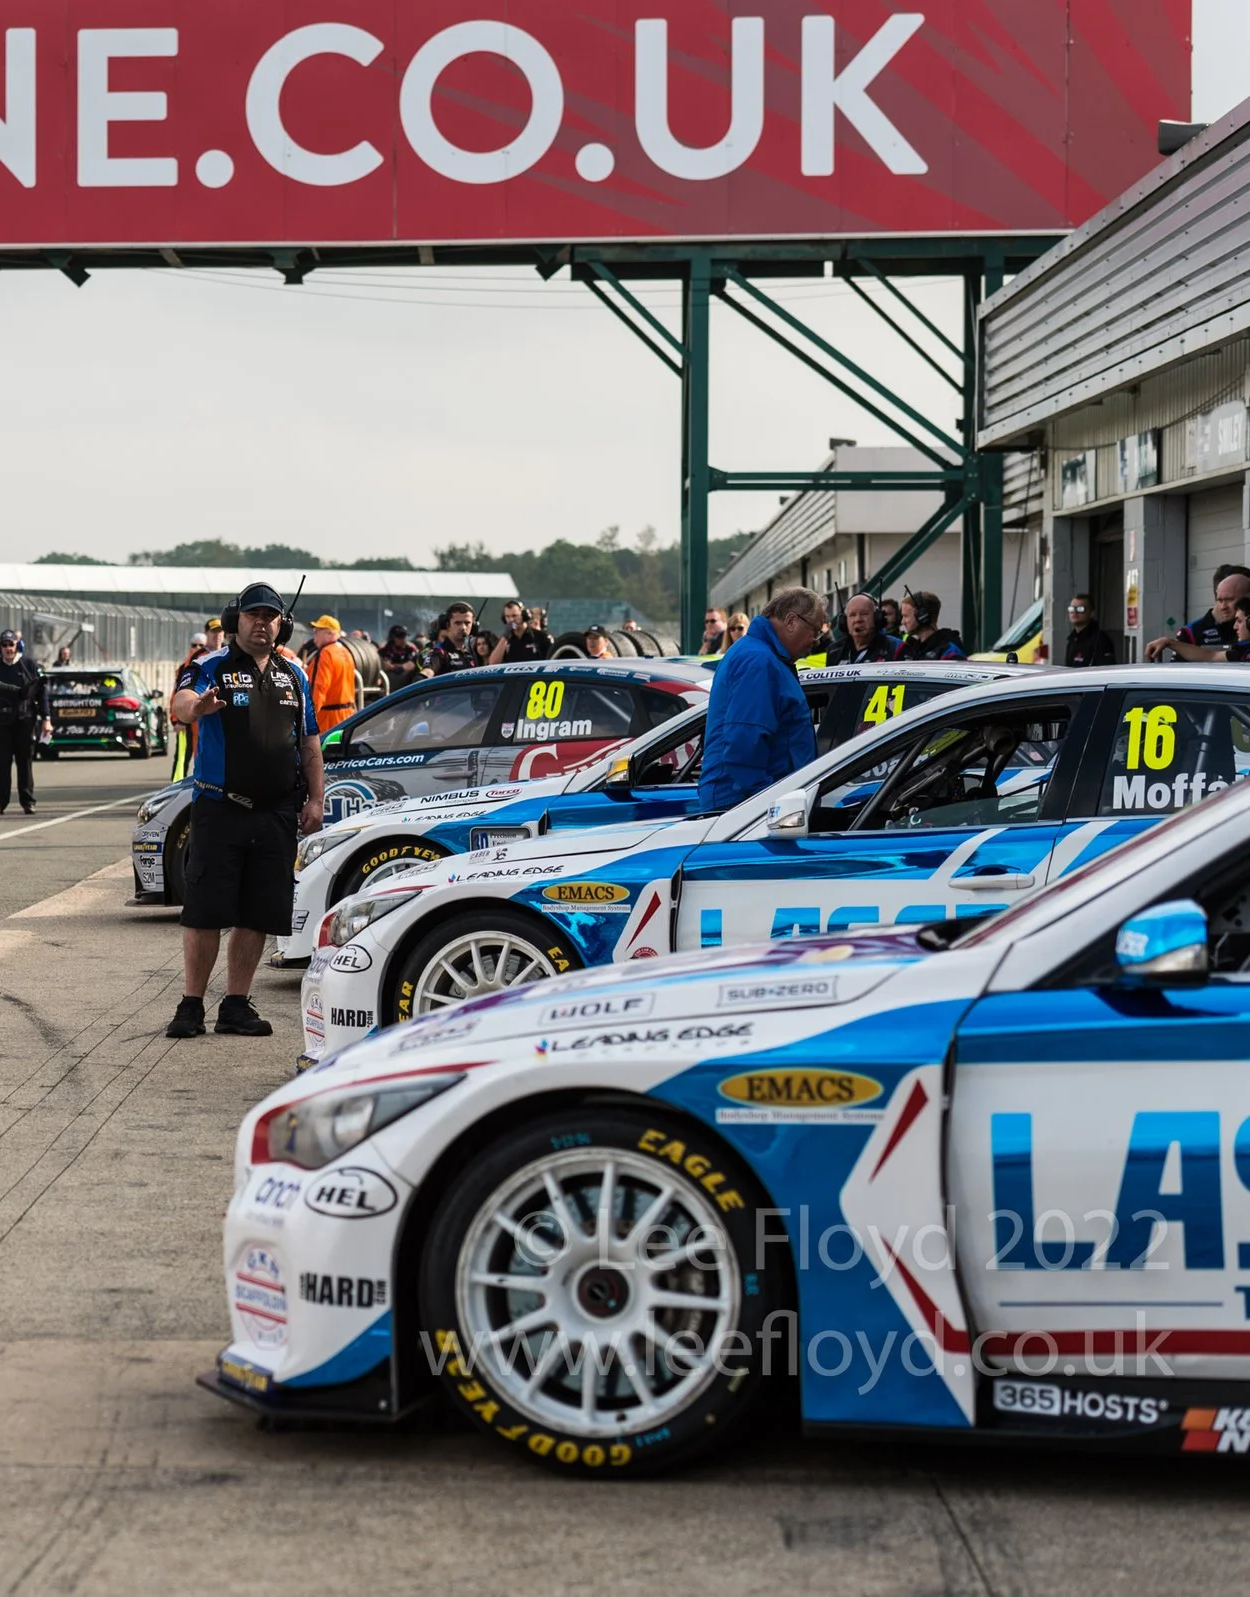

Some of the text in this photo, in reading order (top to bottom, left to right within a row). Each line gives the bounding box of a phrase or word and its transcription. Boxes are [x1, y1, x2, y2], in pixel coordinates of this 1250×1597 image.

[806, 671, 845, 680] COLITIS
[846, 669, 862, 677] UK
[526, 681, 565, 720] 80
[864, 685, 905, 726] 41
[516, 719, 592, 741] Ingram
[1125, 705, 1177, 770] 16
[420, 790, 480, 804] NIMBUS
[1112, 772, 1245, 809] Moff
[362, 846, 441, 874] GOODYEA
[456, 865, 564, 882] LEADING EDGE
[557, 886, 615, 901] EMACS
[333, 955, 362, 969] HEL
[331, 1008, 367, 1028] HARD
[551, 998, 643, 1020] WOLF
[551, 1021, 754, 1054] LEADING EDGE
[747, 1075, 855, 1101] EMACS
[637, 1128, 744, 1213] EAGLE
[316, 1186, 377, 1212] HEL
[990, 1111, 1250, 1271] LA
[305, 1272, 375, 1309] HARD
